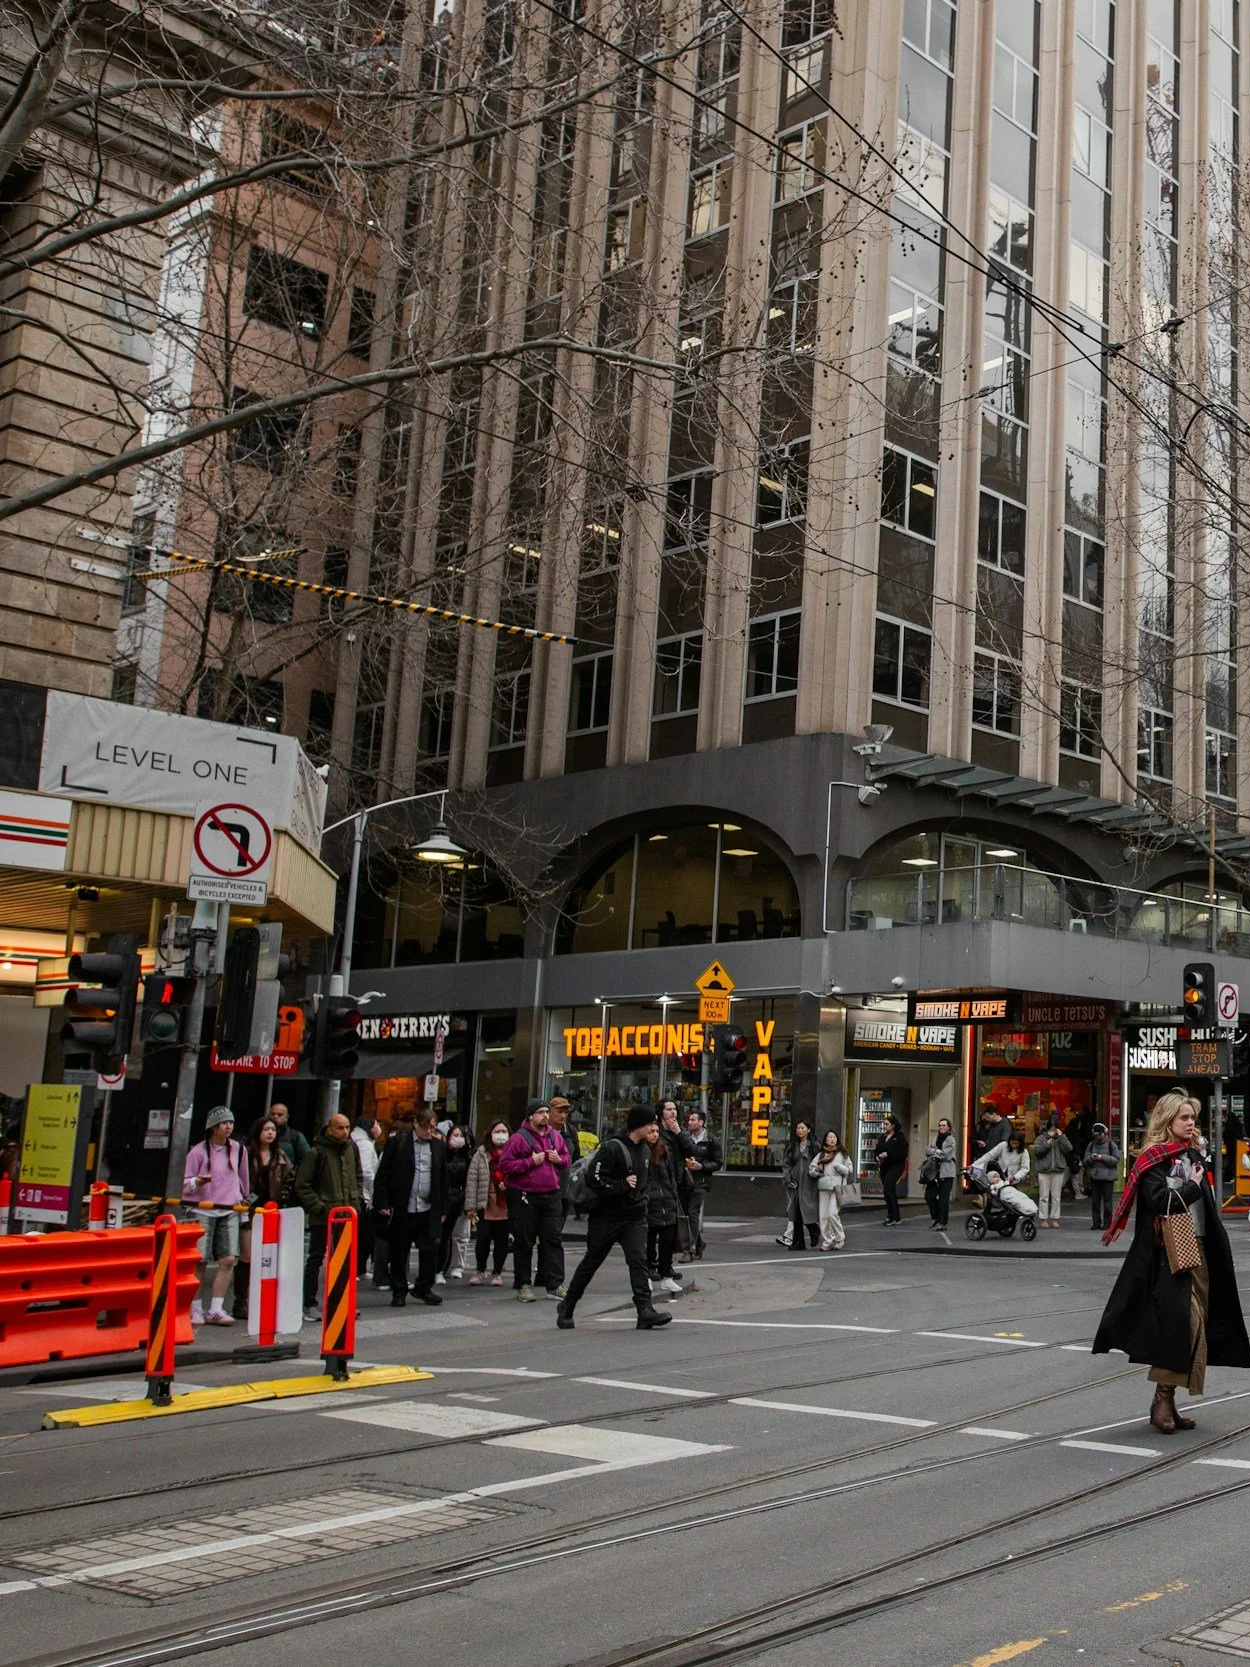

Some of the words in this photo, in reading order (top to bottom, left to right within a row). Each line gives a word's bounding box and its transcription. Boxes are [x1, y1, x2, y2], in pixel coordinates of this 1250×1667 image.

[95, 741, 181, 774] LEVEL
[193, 760, 249, 785] ONE
[192, 880, 228, 889] AUTHORISED
[230, 883, 257, 892] VEHICLES
[198, 889, 226, 898] BICYCLES
[227, 892, 256, 901] EXCEPTED
[704, 1001, 726, 1009] NEXT
[915, 1001, 960, 1019] SMOKE
[960, 1001, 970, 1019] N
[970, 1000, 1007, 1018] VAPE
[390, 1015, 450, 1038] JERRY'S
[853, 1021, 906, 1043] SMOKE
[906, 1026, 918, 1044] N
[918, 1026, 957, 1046] VAPE
[563, 1023, 715, 1057] TOBACCONIS
[1138, 1027, 1177, 1047] SUSHI
[943, 1045, 955, 1053] VAPE
[1190, 1043, 1217, 1053] TRAM
[260, 1055, 270, 1068] TO
[273, 1056, 296, 1070] STOP
[1129, 1047, 1158, 1069] SUSHI
[1192, 1054, 1217, 1063] STOP
[1187, 1064, 1220, 1074] AHEAD
[751, 1020, 775, 1147] VAPE
